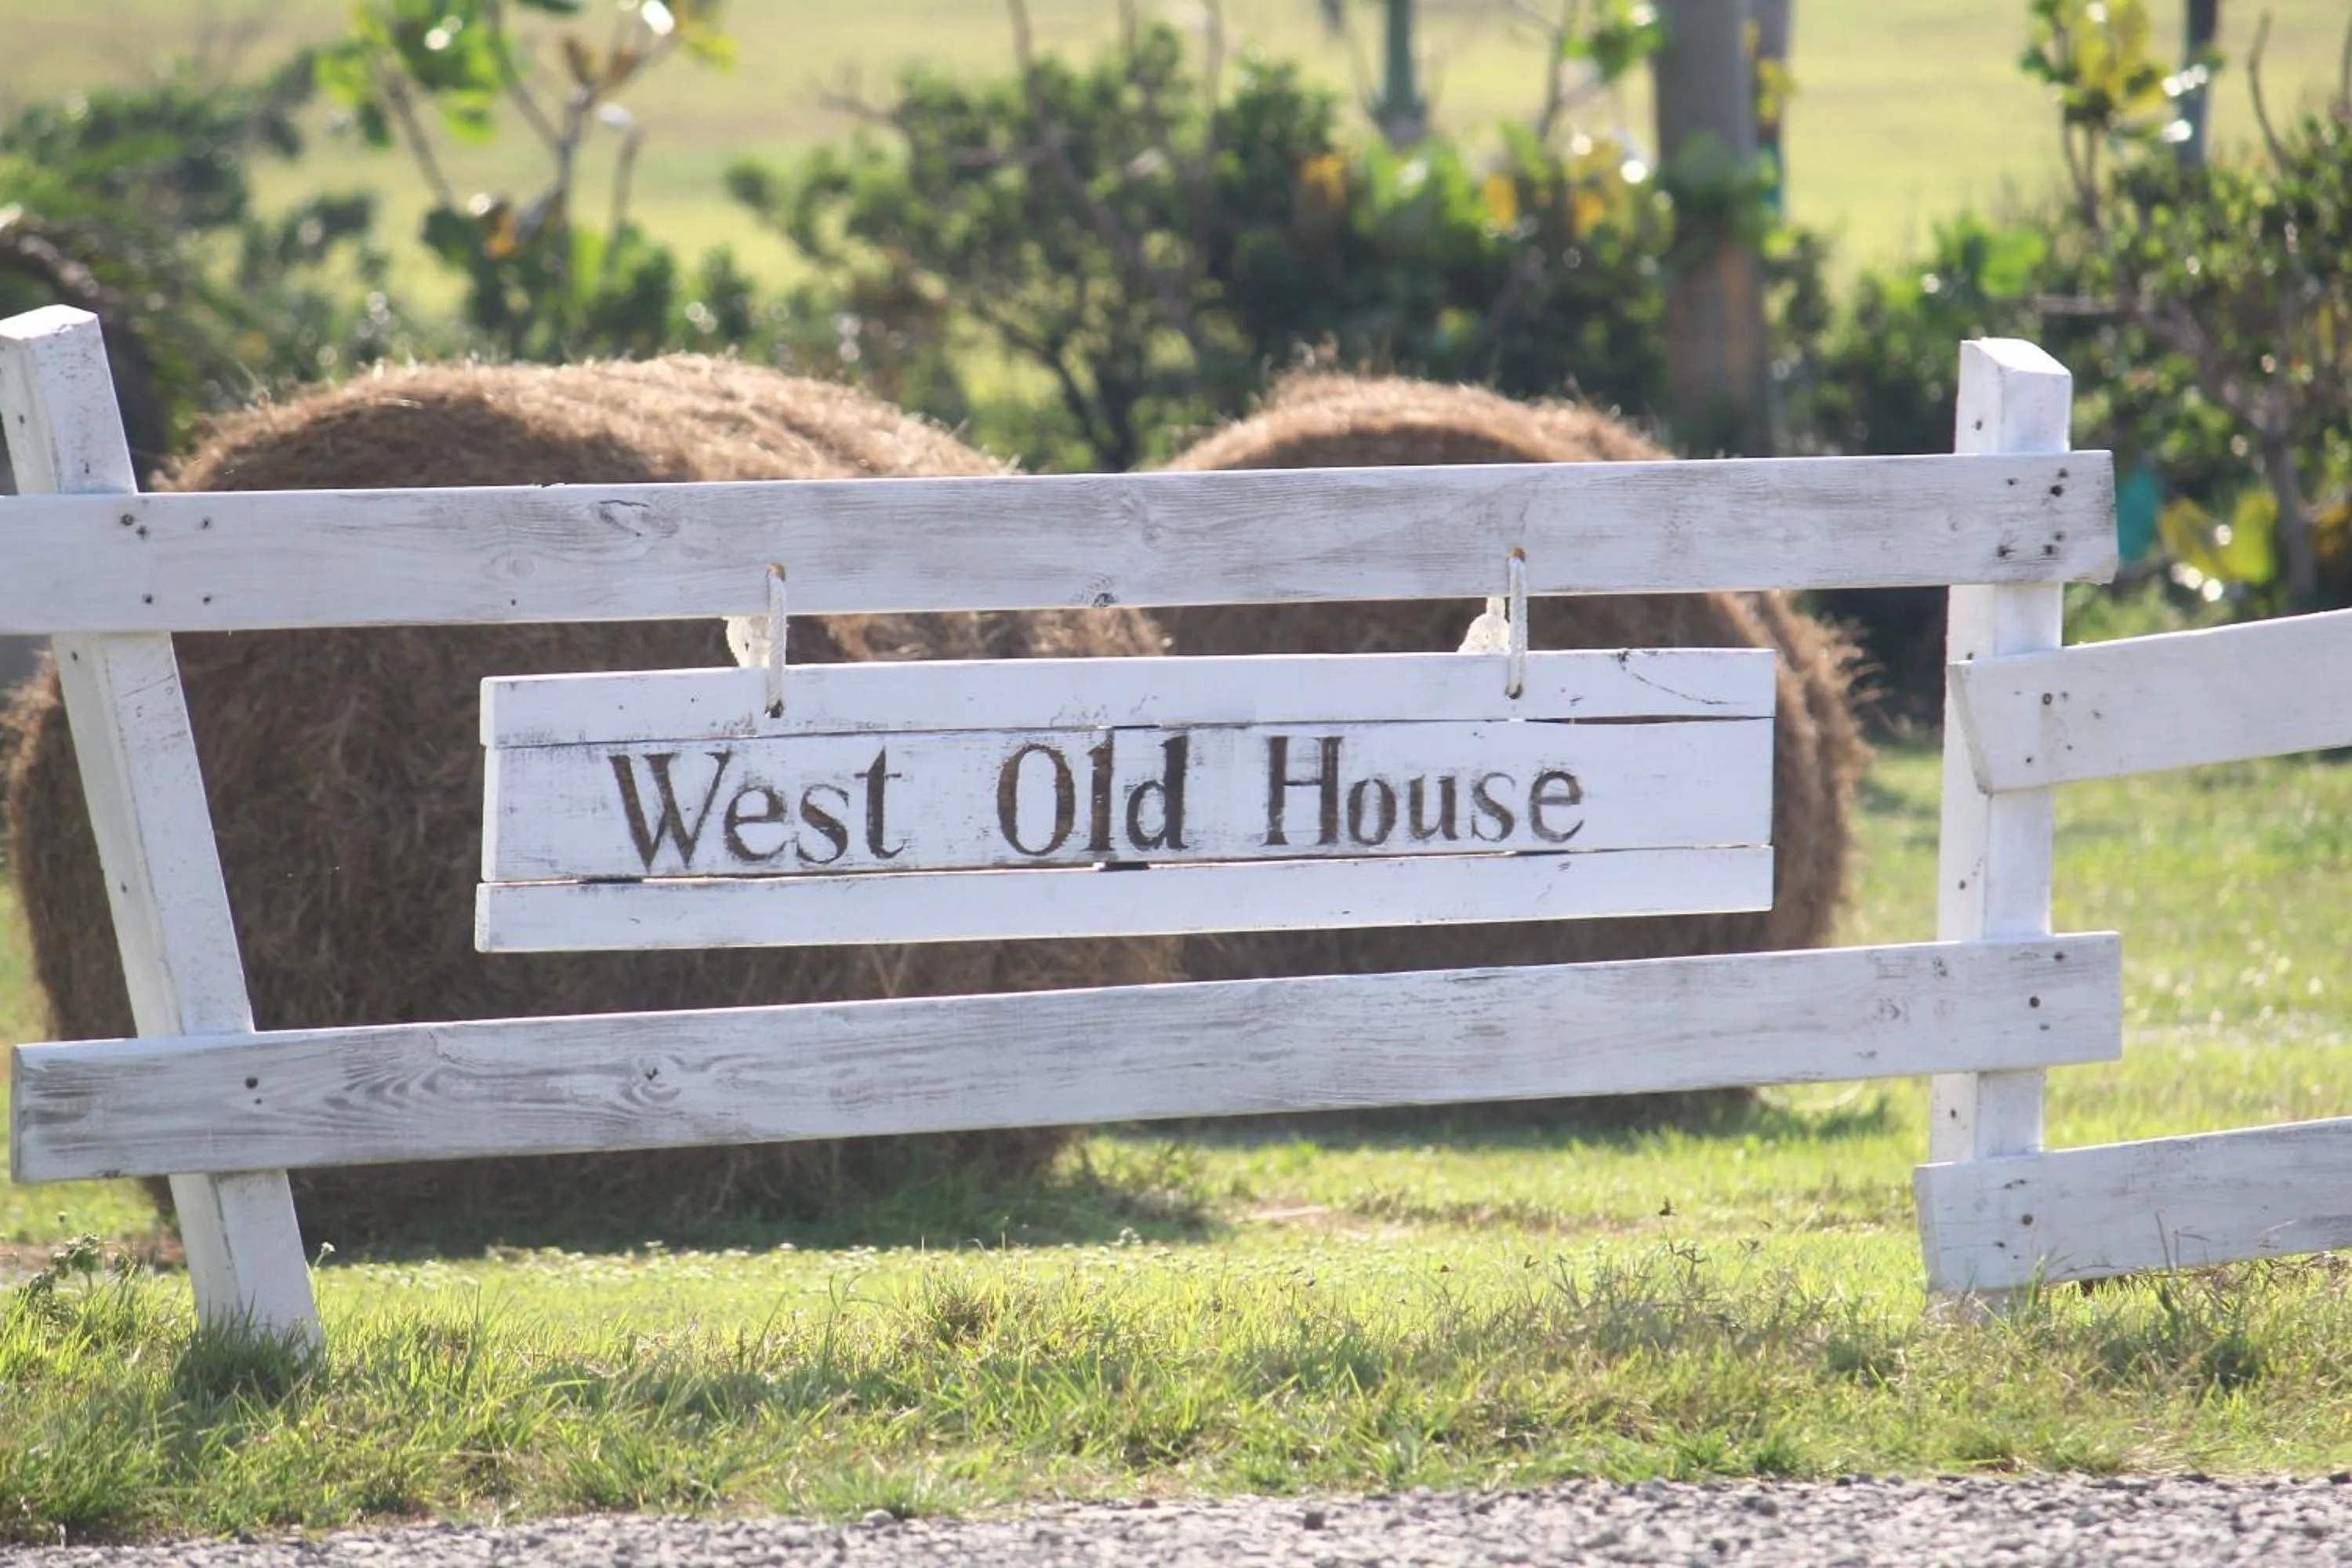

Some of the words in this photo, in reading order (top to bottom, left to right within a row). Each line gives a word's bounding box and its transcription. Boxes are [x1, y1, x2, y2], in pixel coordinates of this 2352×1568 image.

[608, 748, 908, 873] West
[996, 728, 1188, 856] Old
[1264, 735, 1584, 846] House
